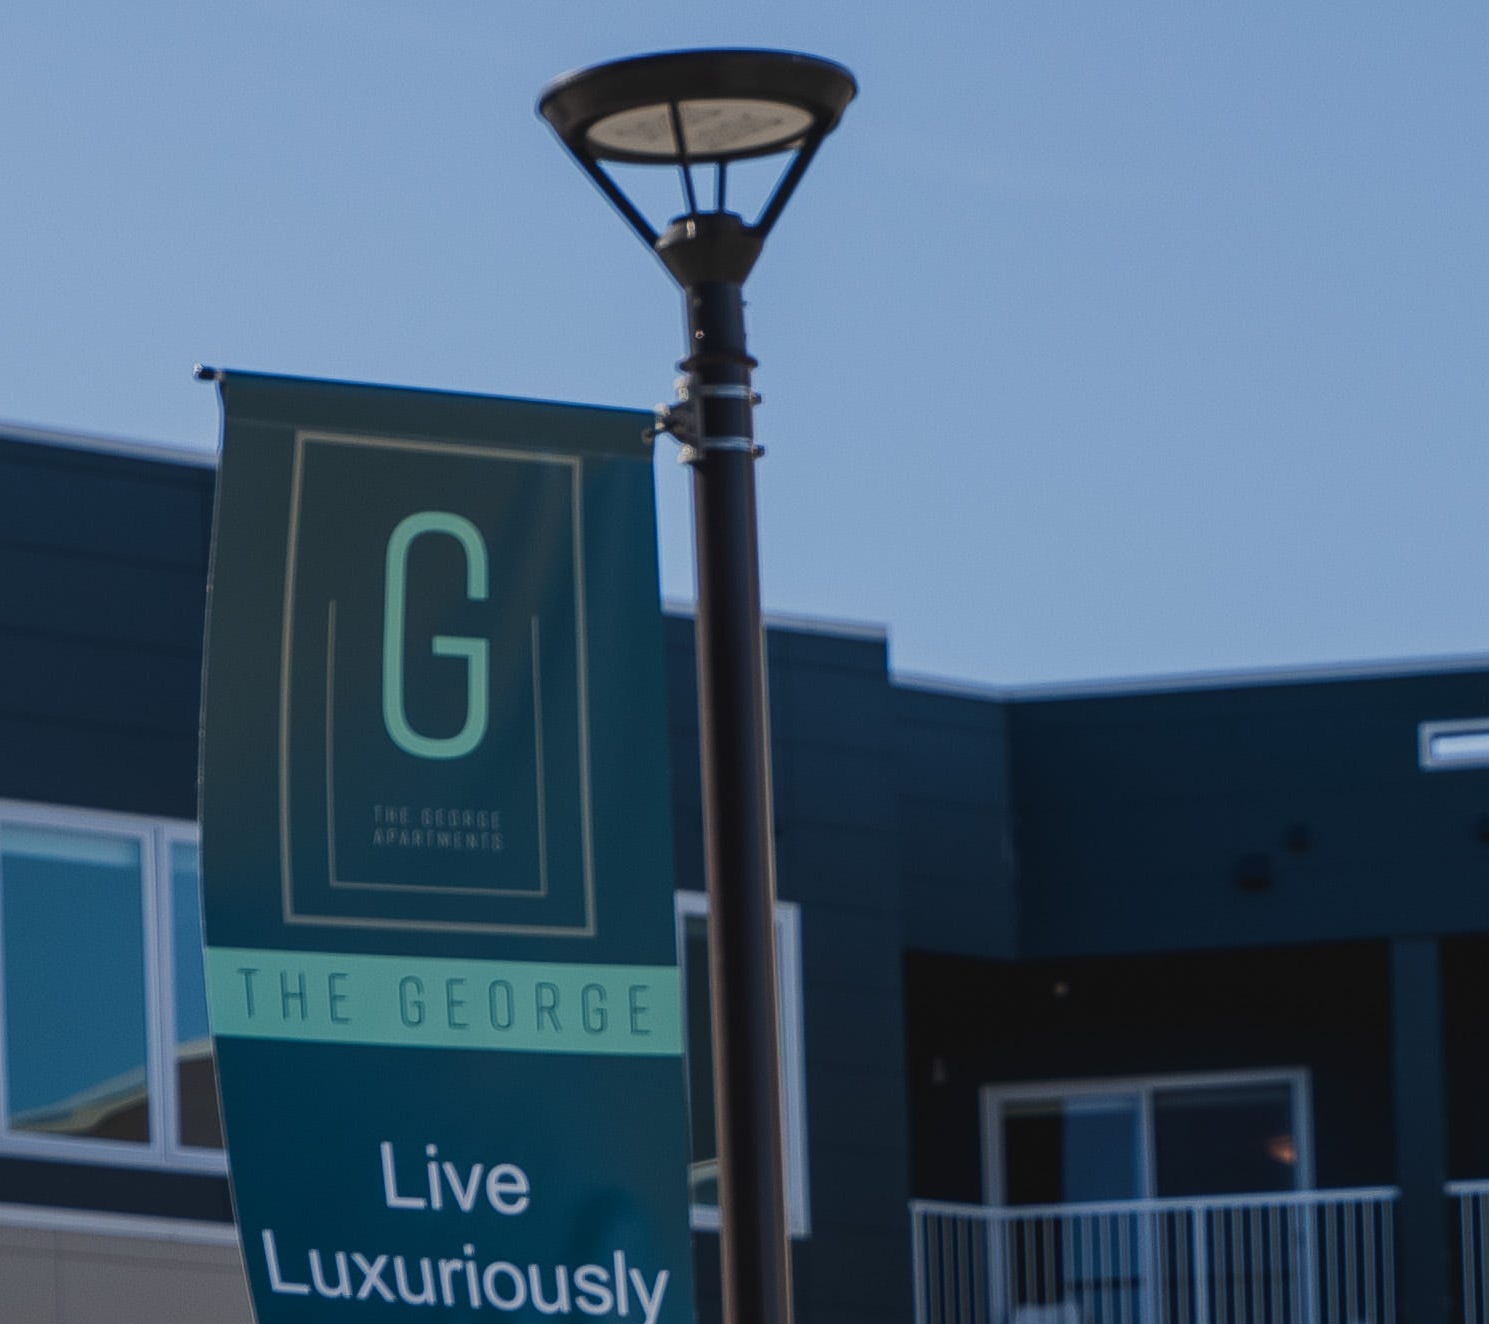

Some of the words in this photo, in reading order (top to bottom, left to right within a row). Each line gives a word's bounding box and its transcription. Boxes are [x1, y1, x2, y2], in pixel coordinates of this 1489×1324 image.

[381, 510, 490, 760] G
[373, 804, 409, 826] THE
[421, 808, 501, 829] GEORGE
[373, 828, 504, 850] APARTMENTS
[236, 967, 351, 1025] THE
[398, 974, 653, 1036] GEORGE
[379, 1142, 531, 1216] Live
